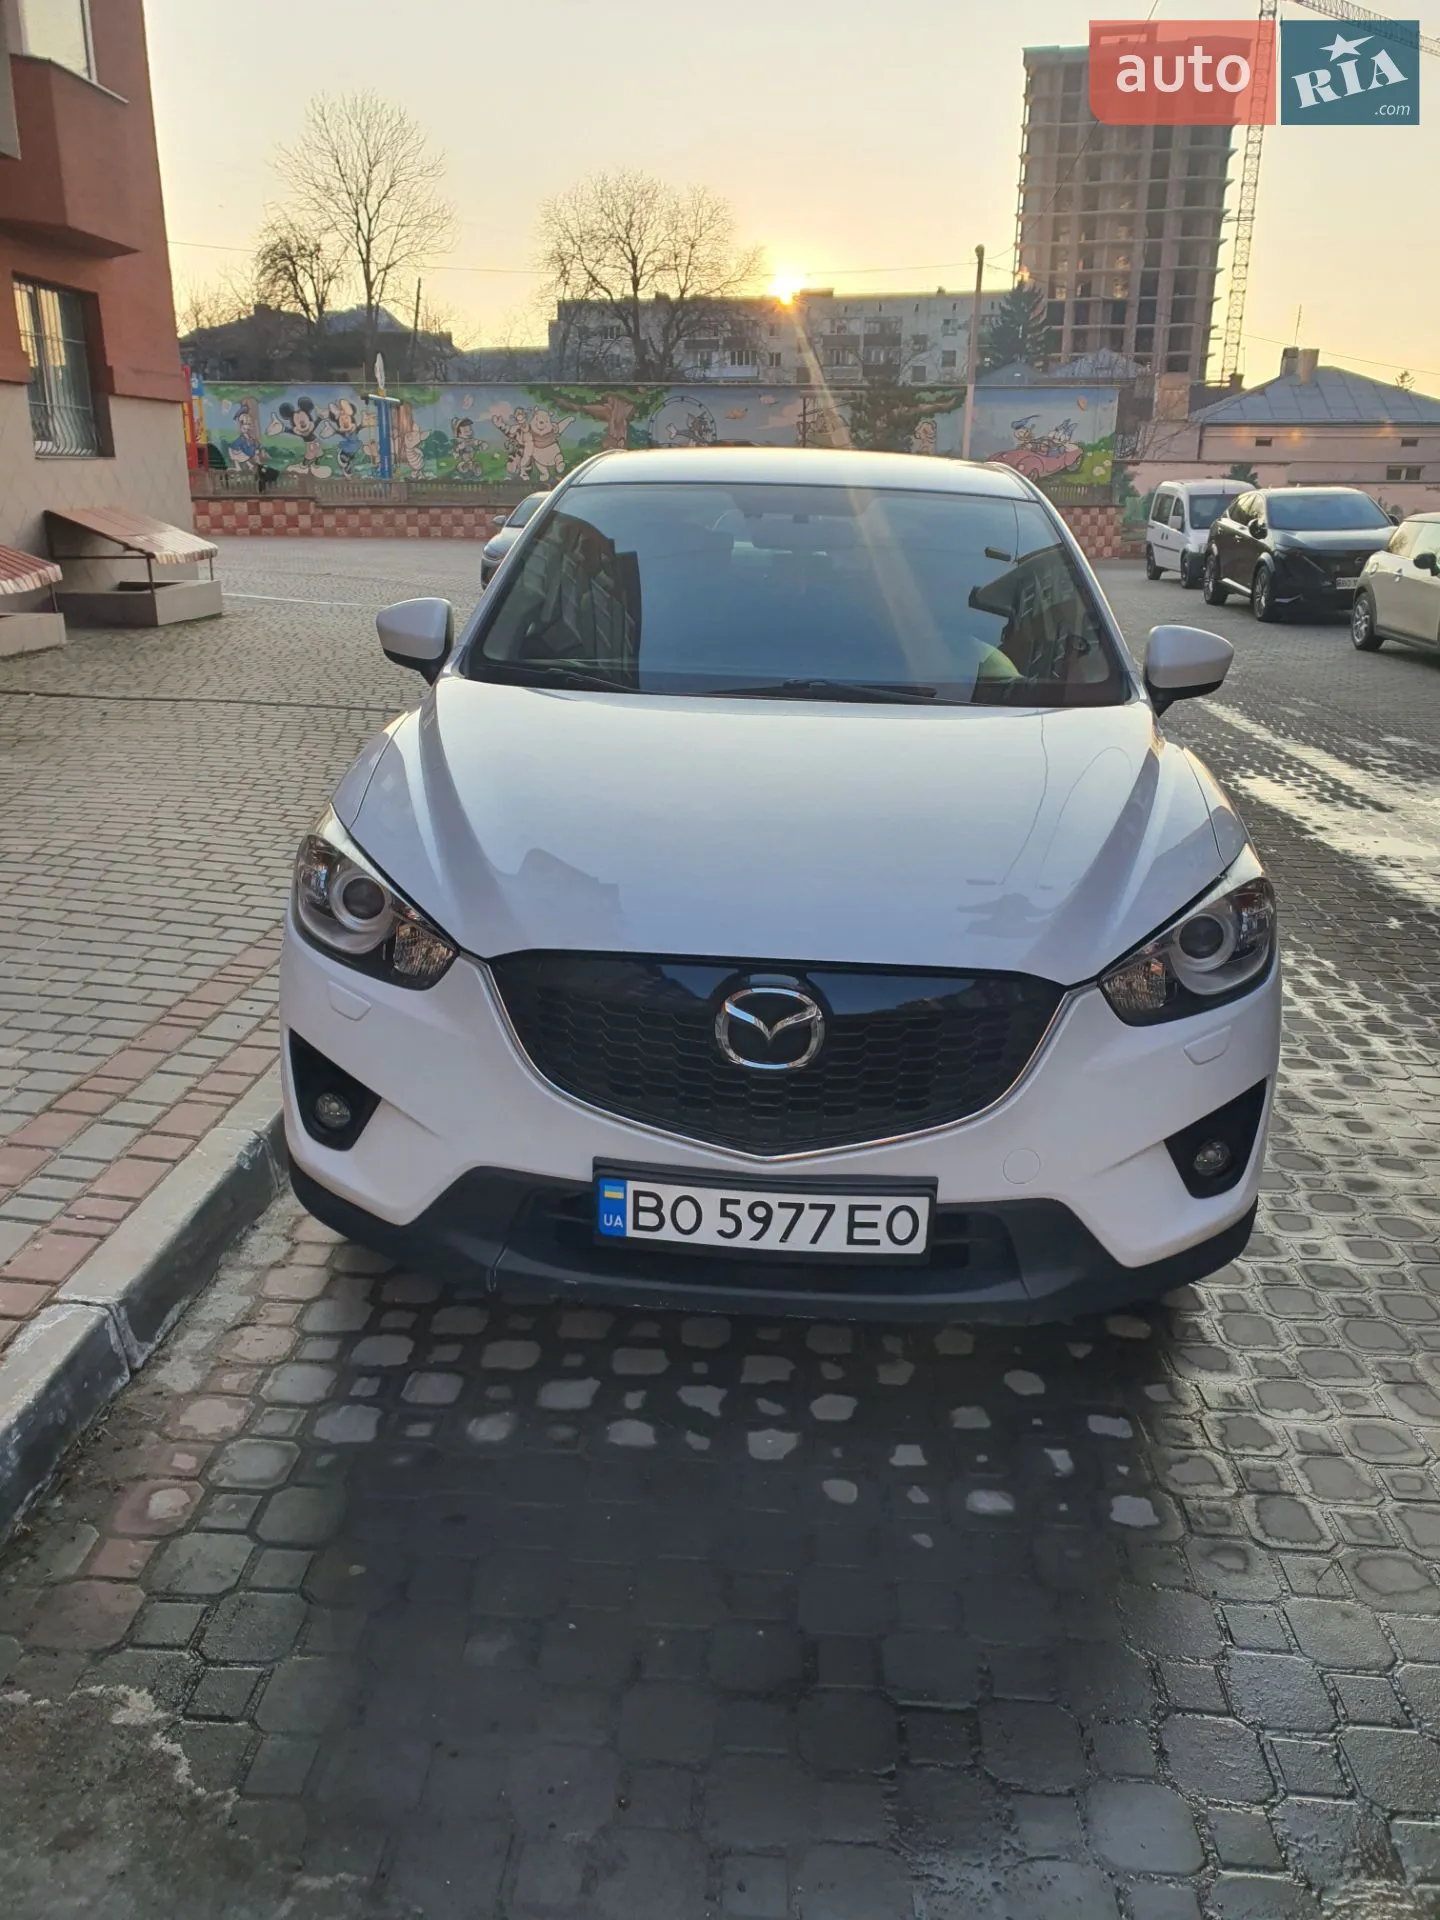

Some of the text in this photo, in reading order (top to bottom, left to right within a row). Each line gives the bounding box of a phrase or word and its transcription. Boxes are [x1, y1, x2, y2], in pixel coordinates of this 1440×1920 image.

[603, 1215, 624, 1228] UA
[632, 1190, 920, 1246] BO 5977 EO
